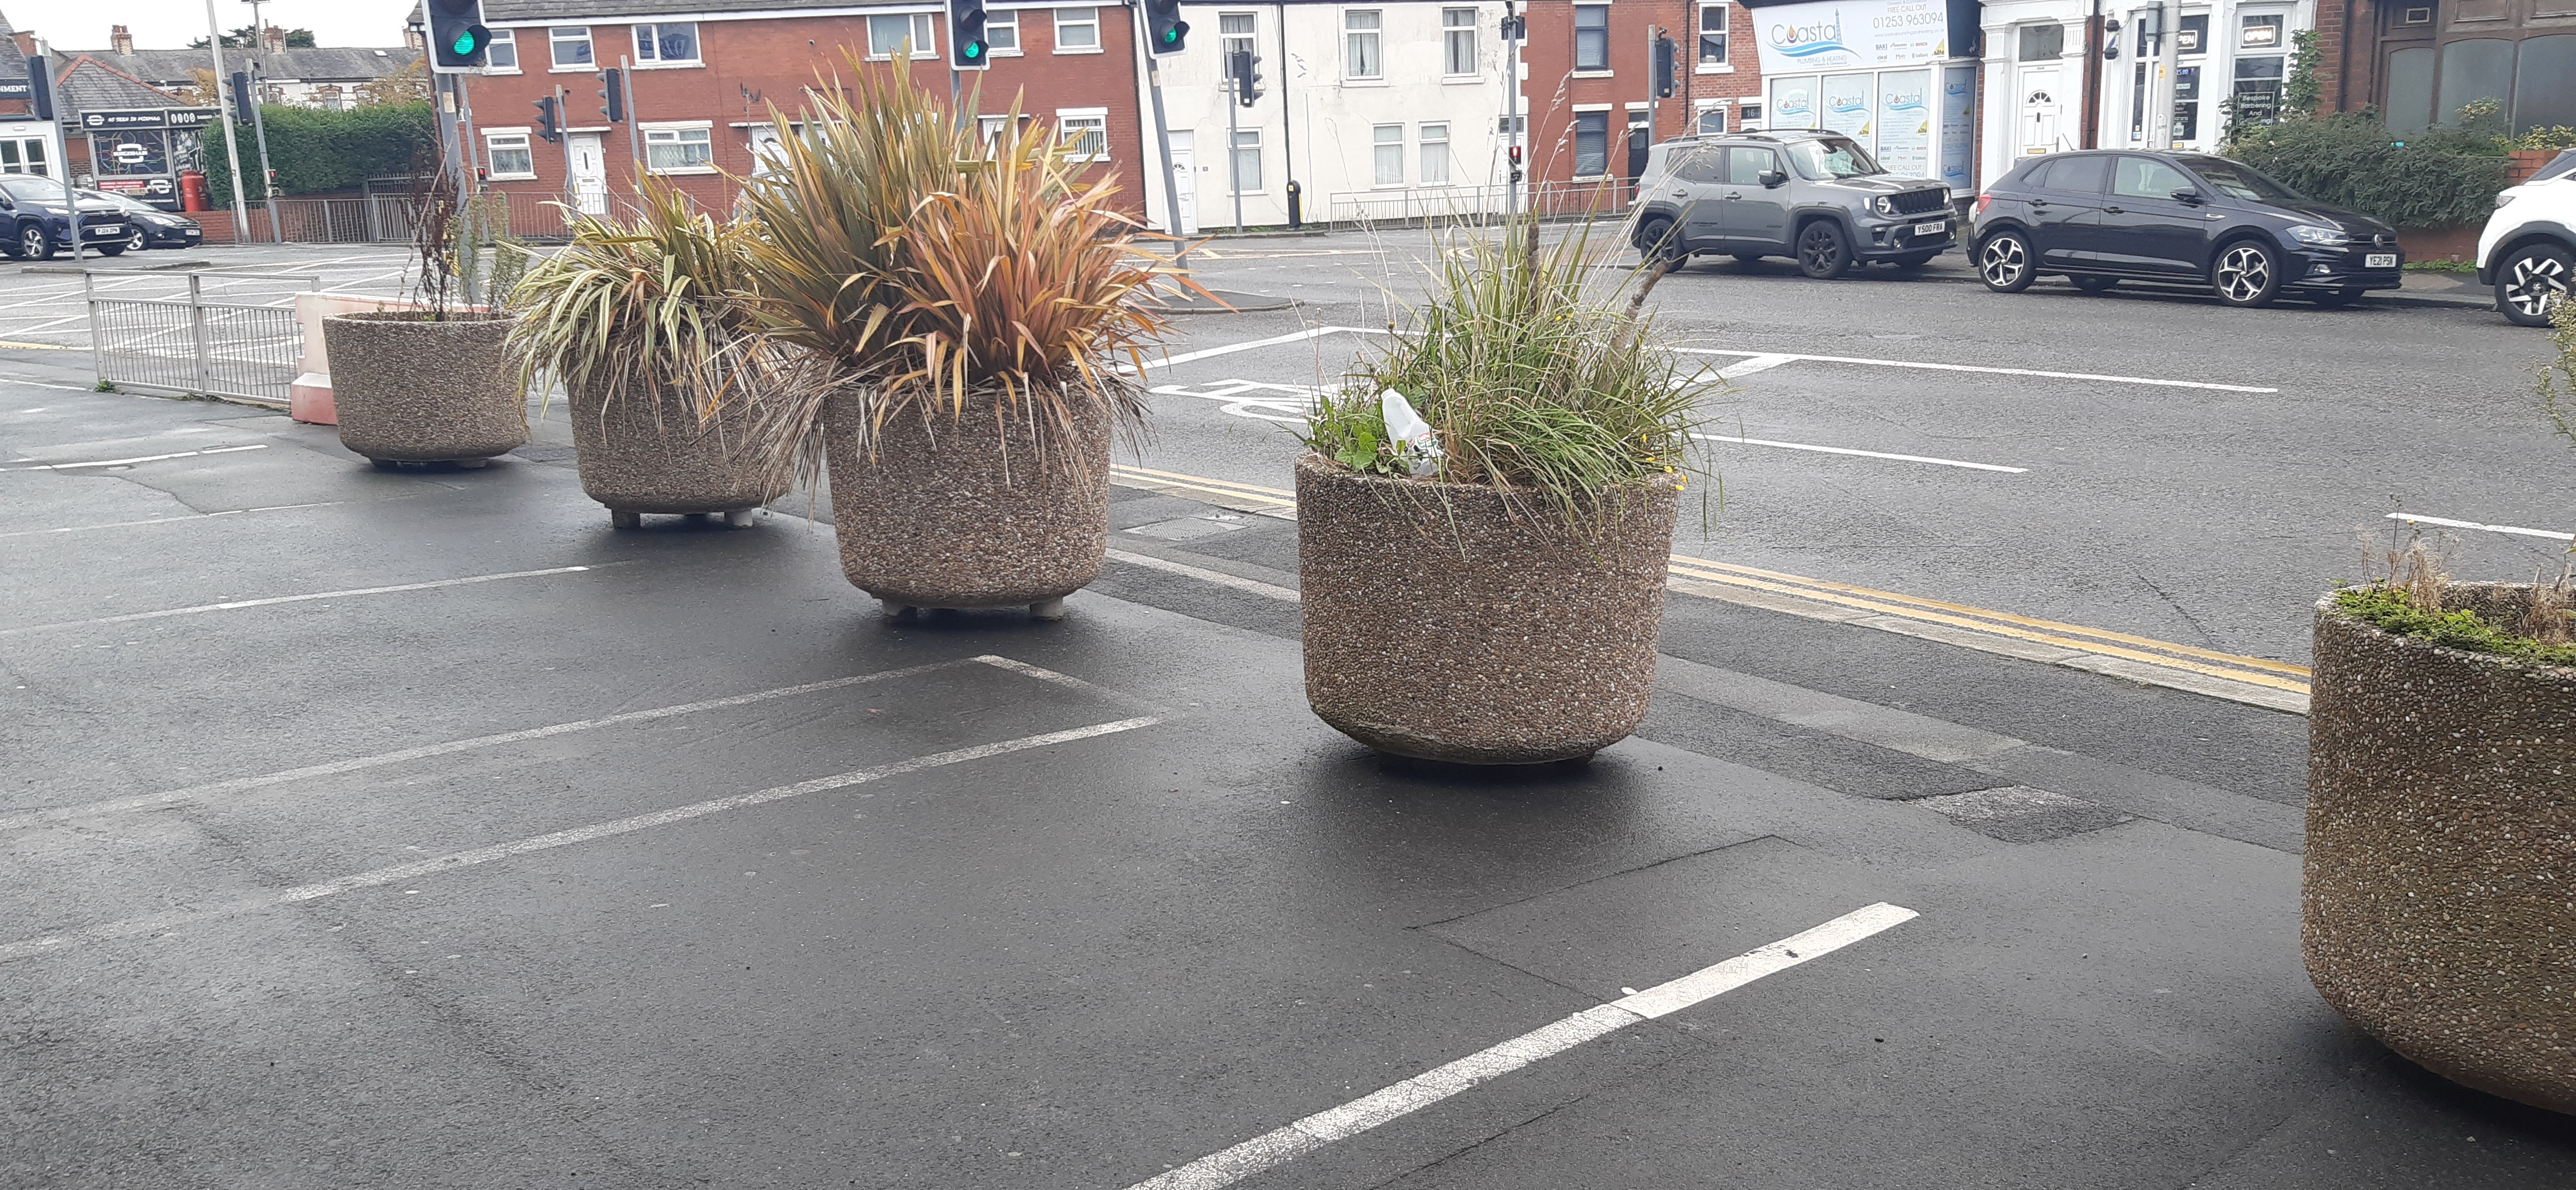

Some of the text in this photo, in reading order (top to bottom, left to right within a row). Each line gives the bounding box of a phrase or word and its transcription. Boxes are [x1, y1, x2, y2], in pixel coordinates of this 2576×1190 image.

[1771, 8, 1843, 45] Coastal
[1873, 12, 1944, 29] 01253 963094
[1829, 89, 1865, 107] Coastal
[1885, 87, 1922, 105] Coastal
[1918, 225, 1932, 234] Y500
[2369, 256, 2393, 266] YE21 PSN
